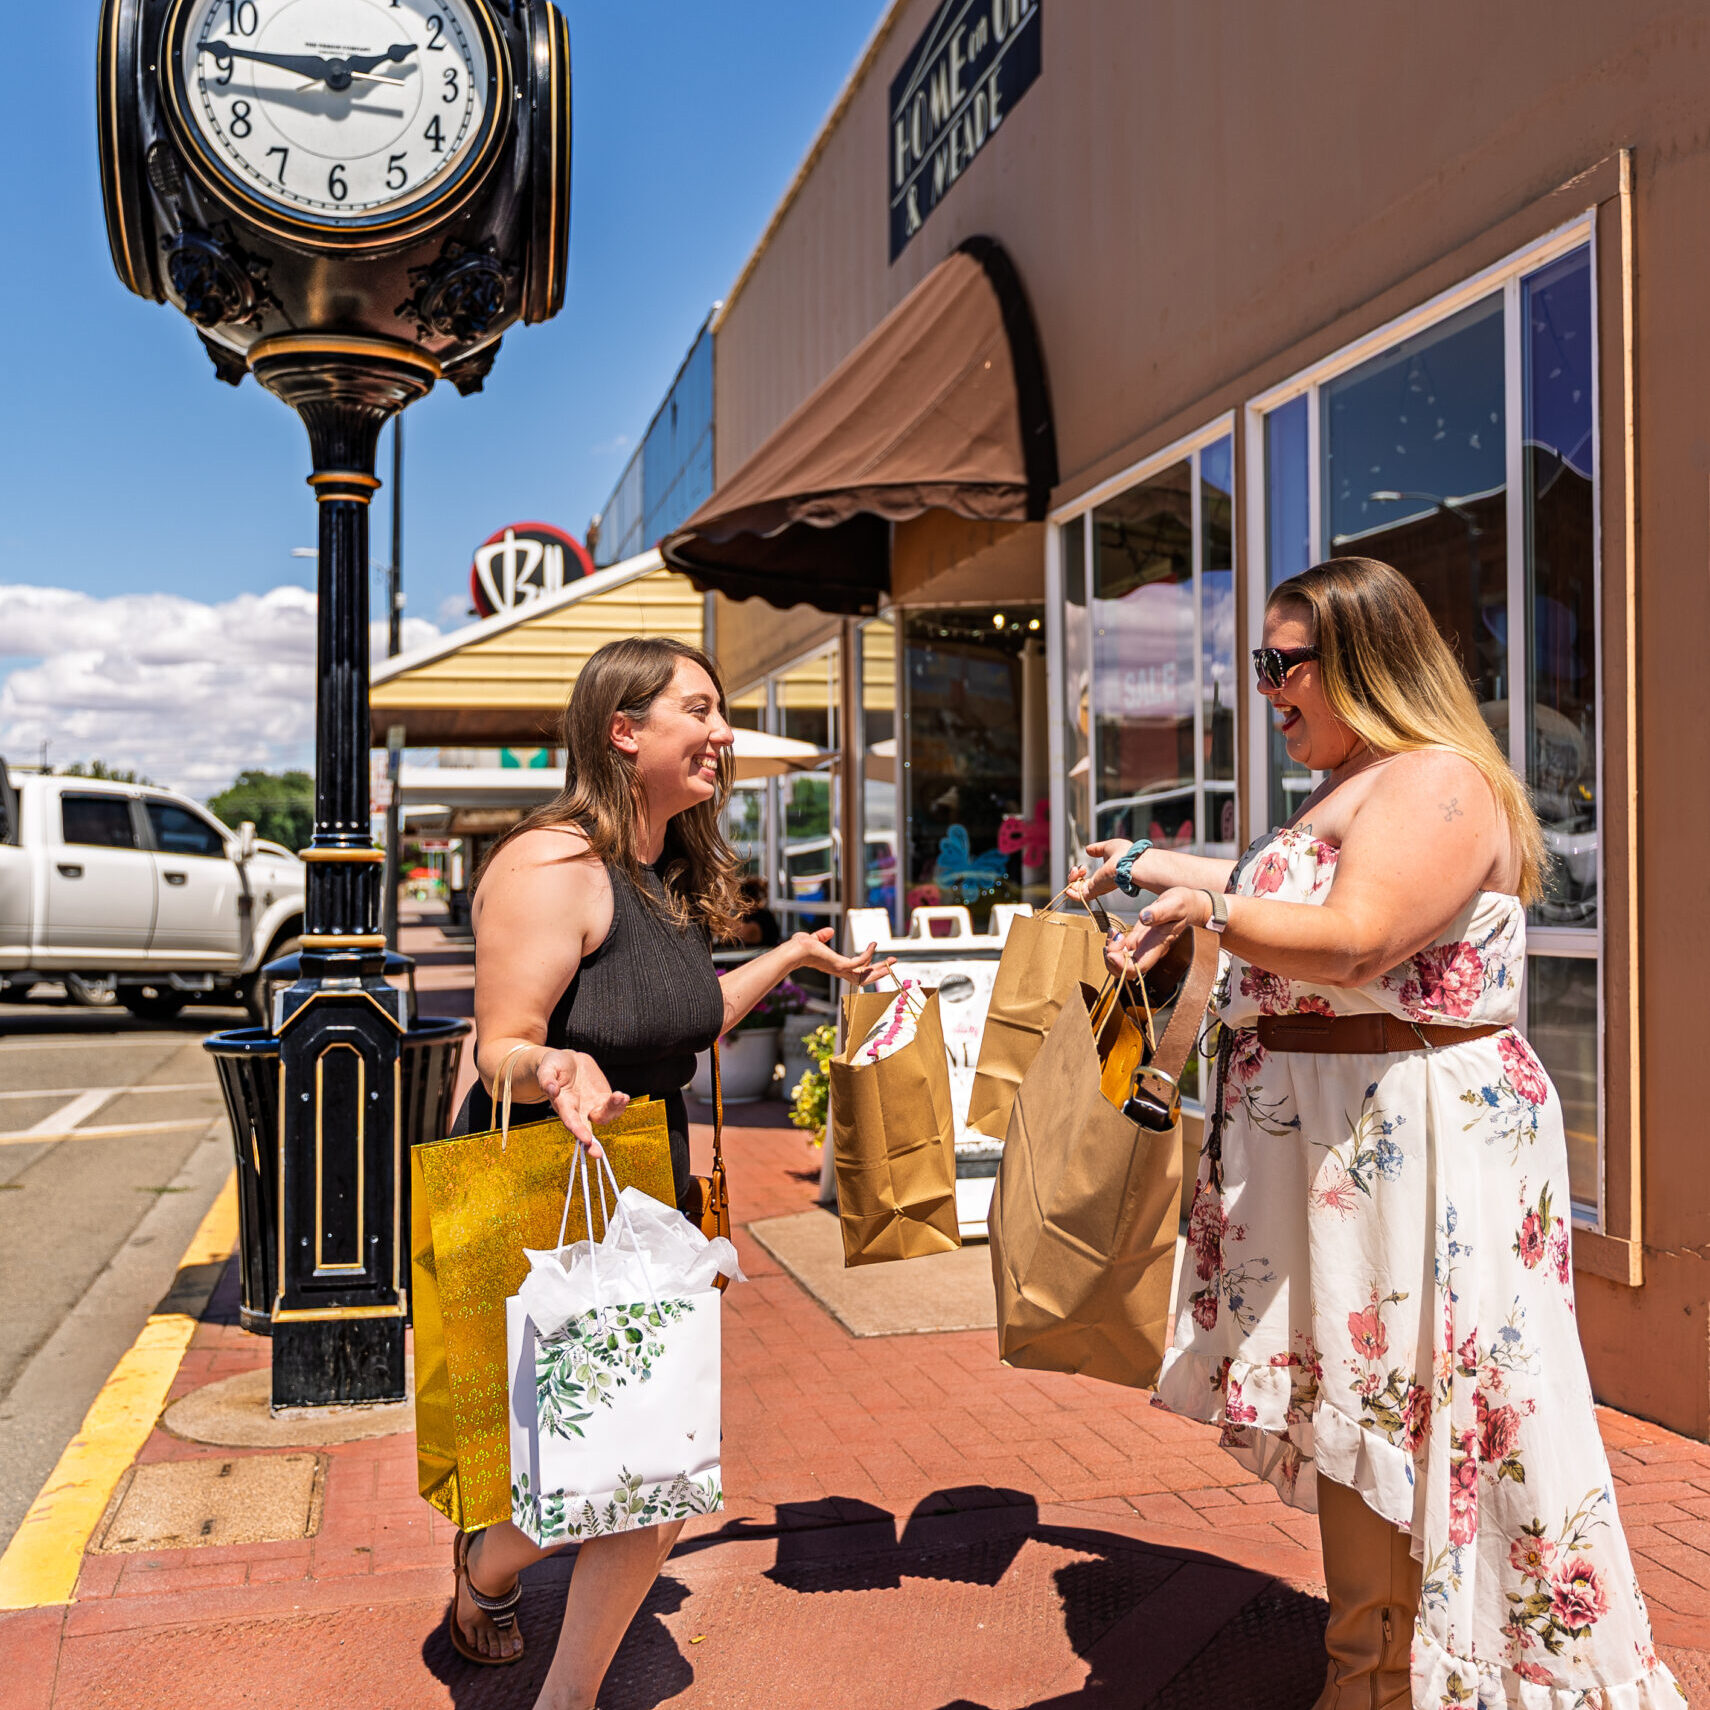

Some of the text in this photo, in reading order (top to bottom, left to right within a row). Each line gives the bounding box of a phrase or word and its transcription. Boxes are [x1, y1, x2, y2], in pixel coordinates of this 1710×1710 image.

[225, 0, 258, 37] 10
[426, 14, 447, 52] 2
[214, 54, 234, 86] 9
[442, 67, 460, 104] 3
[229, 100, 253, 139] 8
[895, 23, 967, 188] HOME
[423, 114, 447, 153] 4
[930, 65, 1003, 208] MEADE
[265, 147, 290, 186] 7
[328, 164, 349, 202] 6
[385, 152, 409, 190] 5
[1123, 662, 1177, 709] SALE
